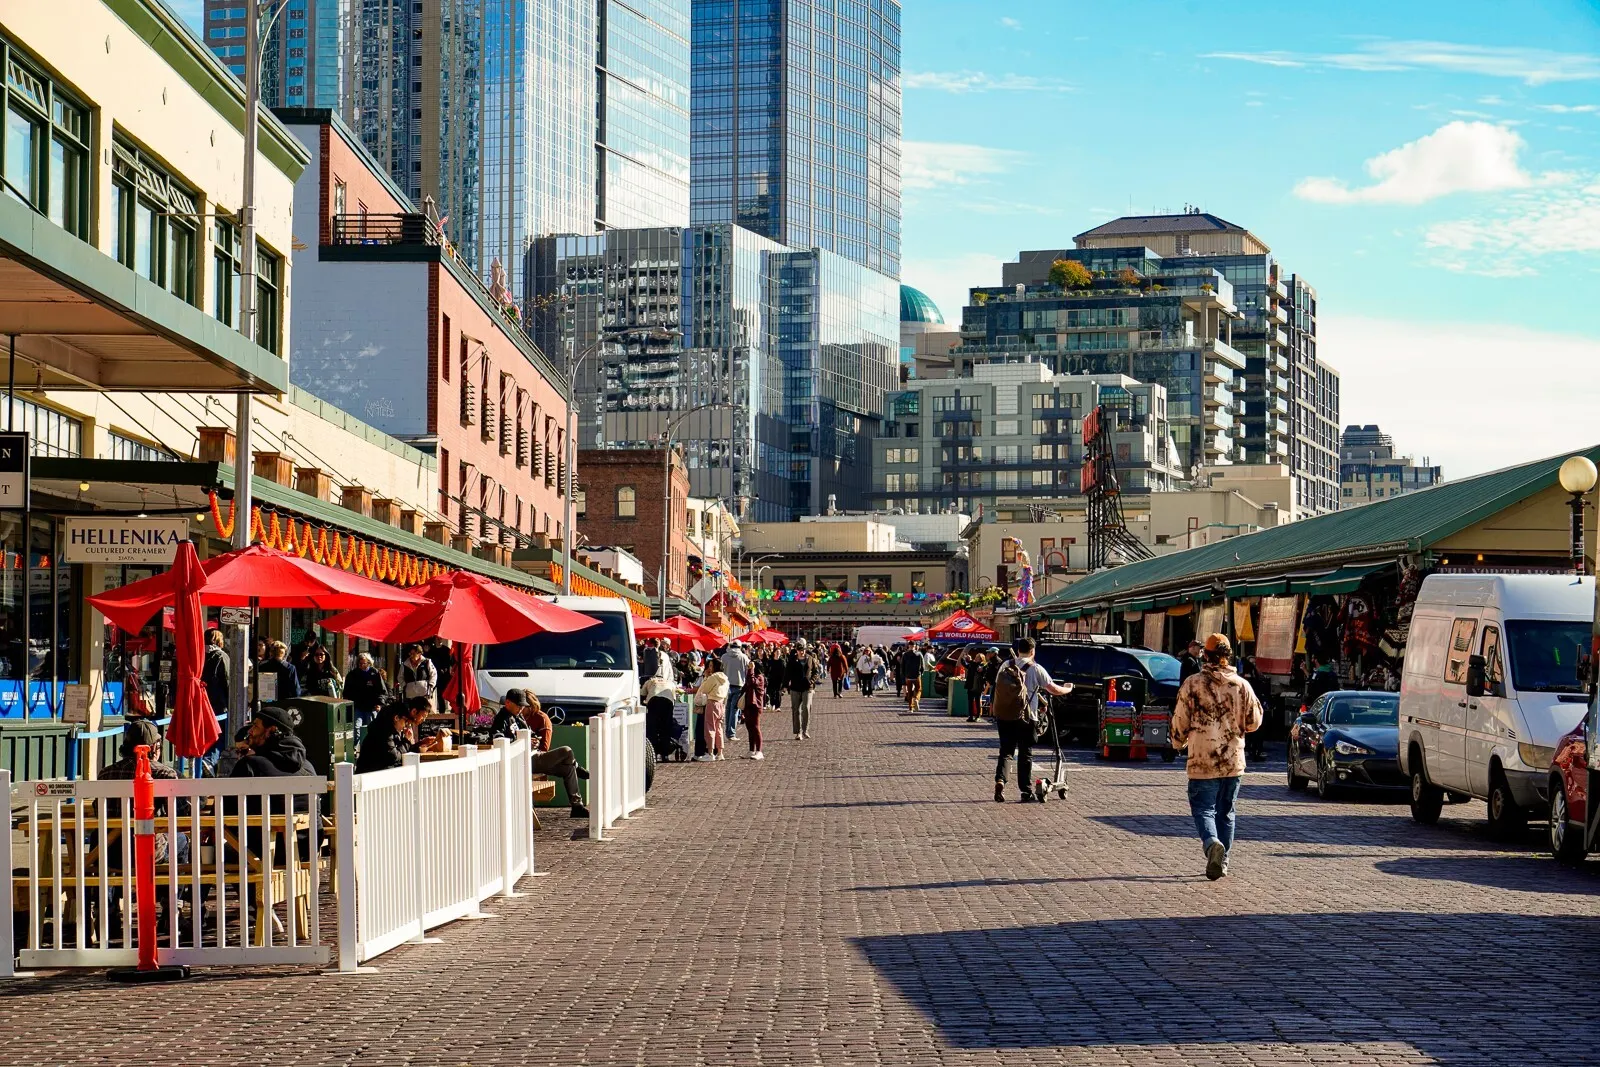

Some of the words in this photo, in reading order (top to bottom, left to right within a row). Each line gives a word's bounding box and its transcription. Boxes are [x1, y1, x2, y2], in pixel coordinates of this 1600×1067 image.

[2, 448, 11, 458] N
[1, 485, 11, 495] T
[71, 528, 180, 545] HELLENIKA
